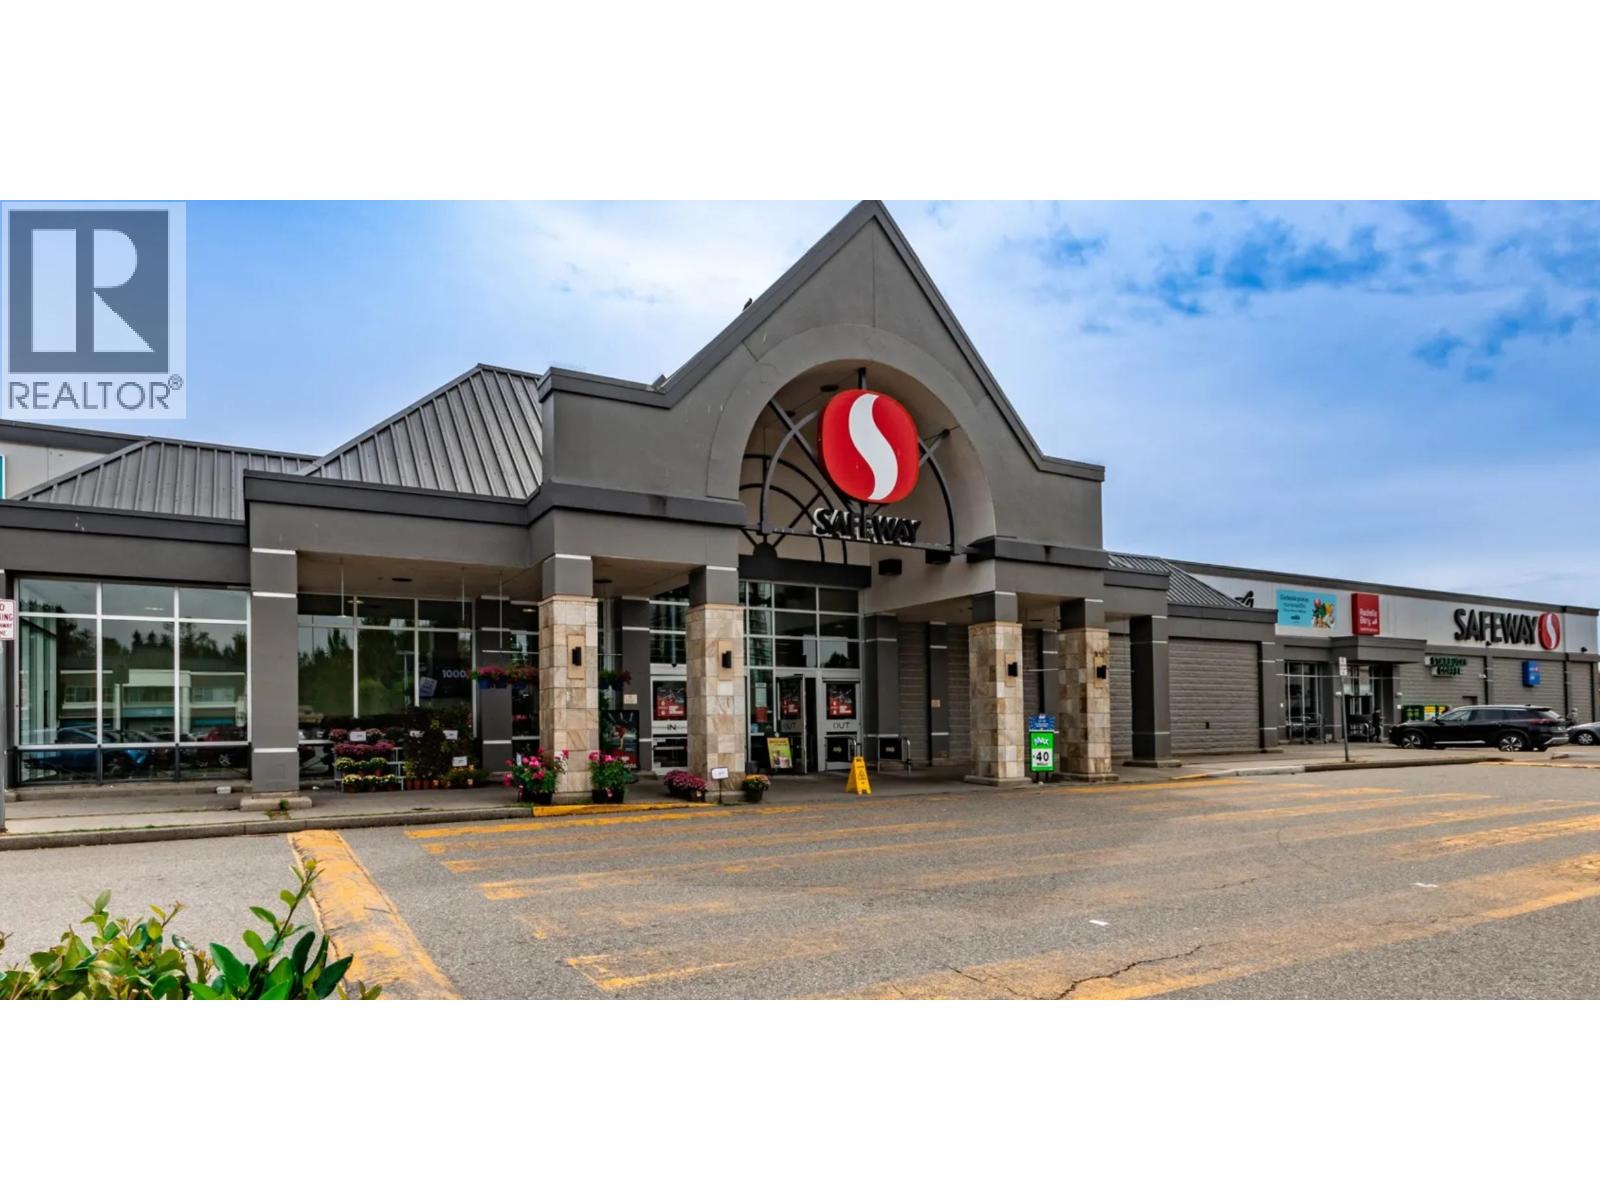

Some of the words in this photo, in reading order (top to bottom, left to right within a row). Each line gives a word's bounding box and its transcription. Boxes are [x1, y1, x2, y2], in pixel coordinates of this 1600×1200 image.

[812, 508, 920, 545] SAFEWAY
[1453, 608, 1538, 644] SAFEWAY
[832, 721, 850, 730] OUT
[1036, 751, 1049, 762] 40
